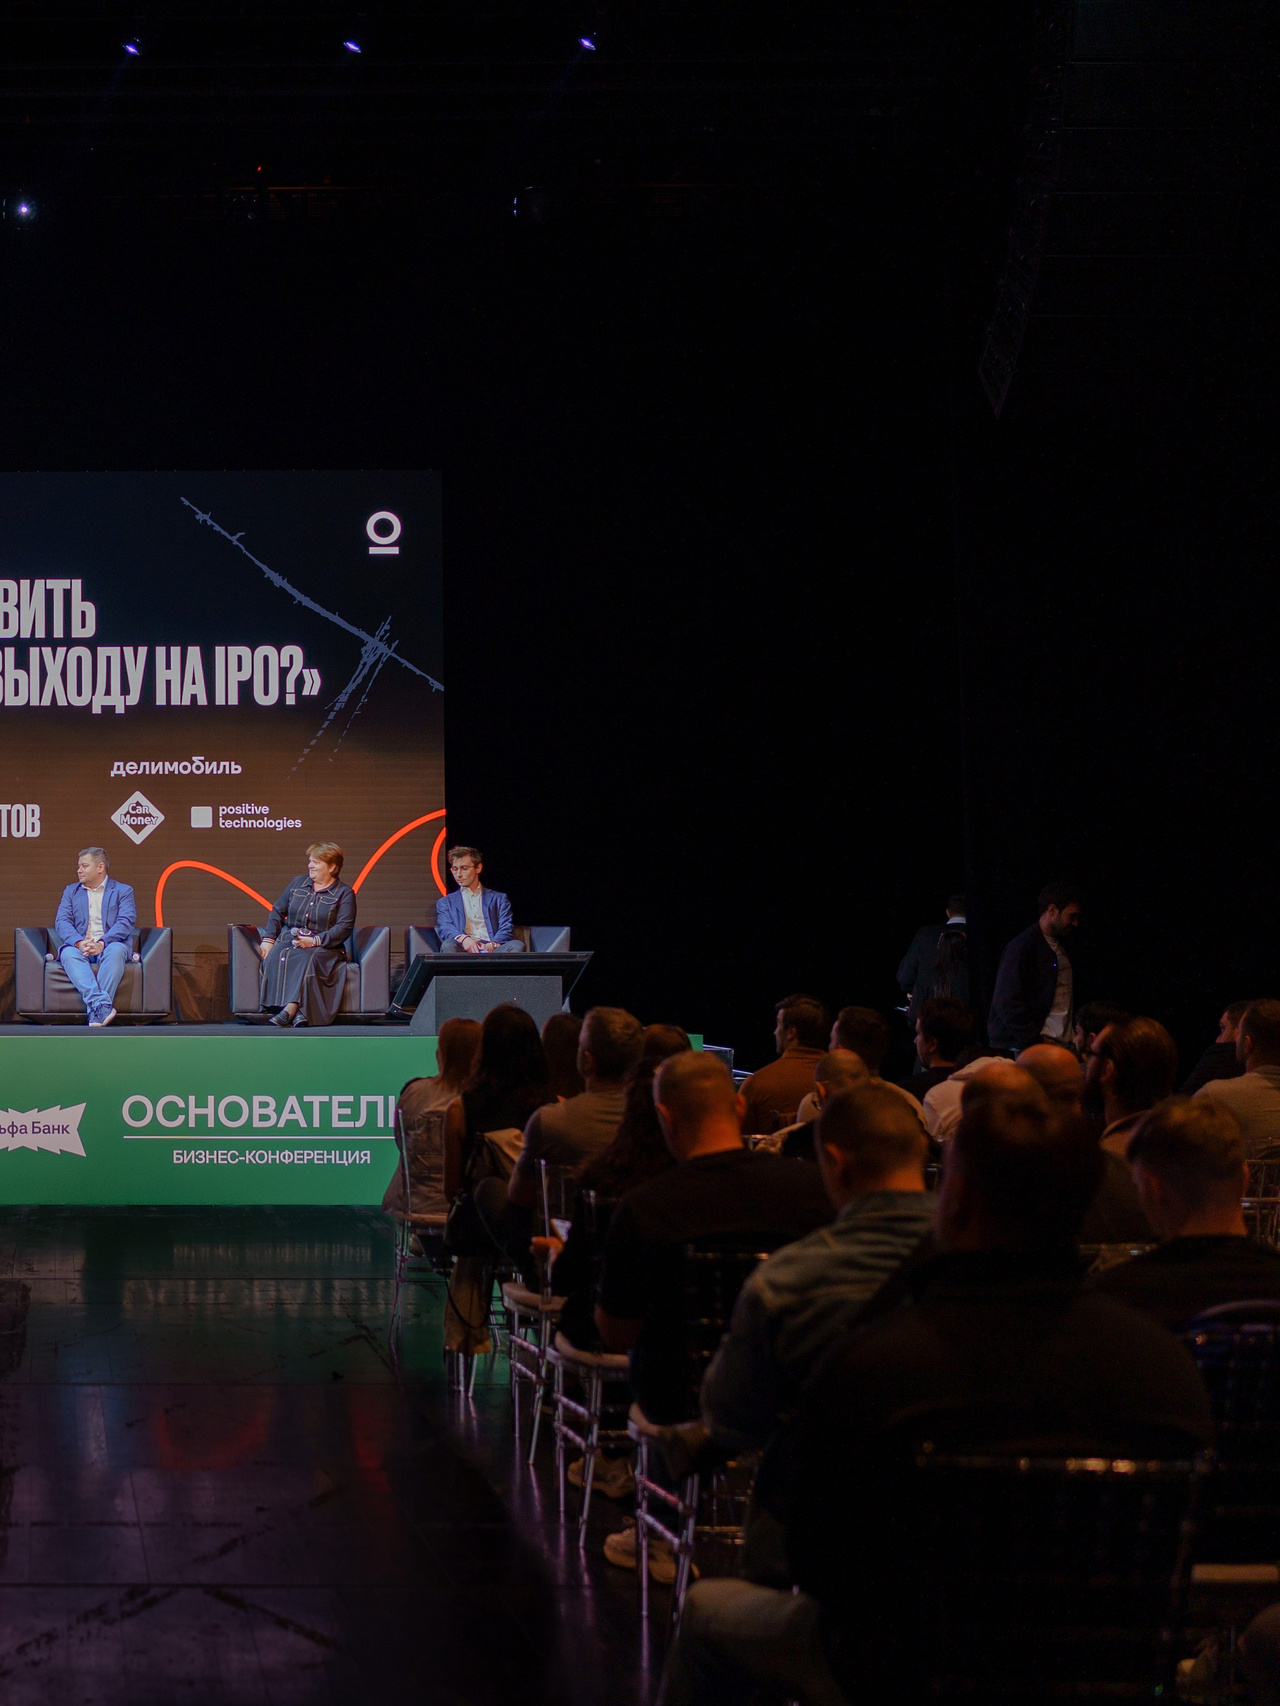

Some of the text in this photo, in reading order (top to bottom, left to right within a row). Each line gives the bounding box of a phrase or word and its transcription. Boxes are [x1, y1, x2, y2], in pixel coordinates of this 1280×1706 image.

[155, 646, 208, 706] НА
[214, 645, 322, 706] IPO?»
[110, 756, 242, 777] делимобиль
[219, 804, 270, 816] positive
[219, 817, 302, 831] technologies
[31, 1121, 70, 1135] Банк
[173, 1150, 371, 1166] БИЗНЕС-КОНФЕРЕНЦИЯ
